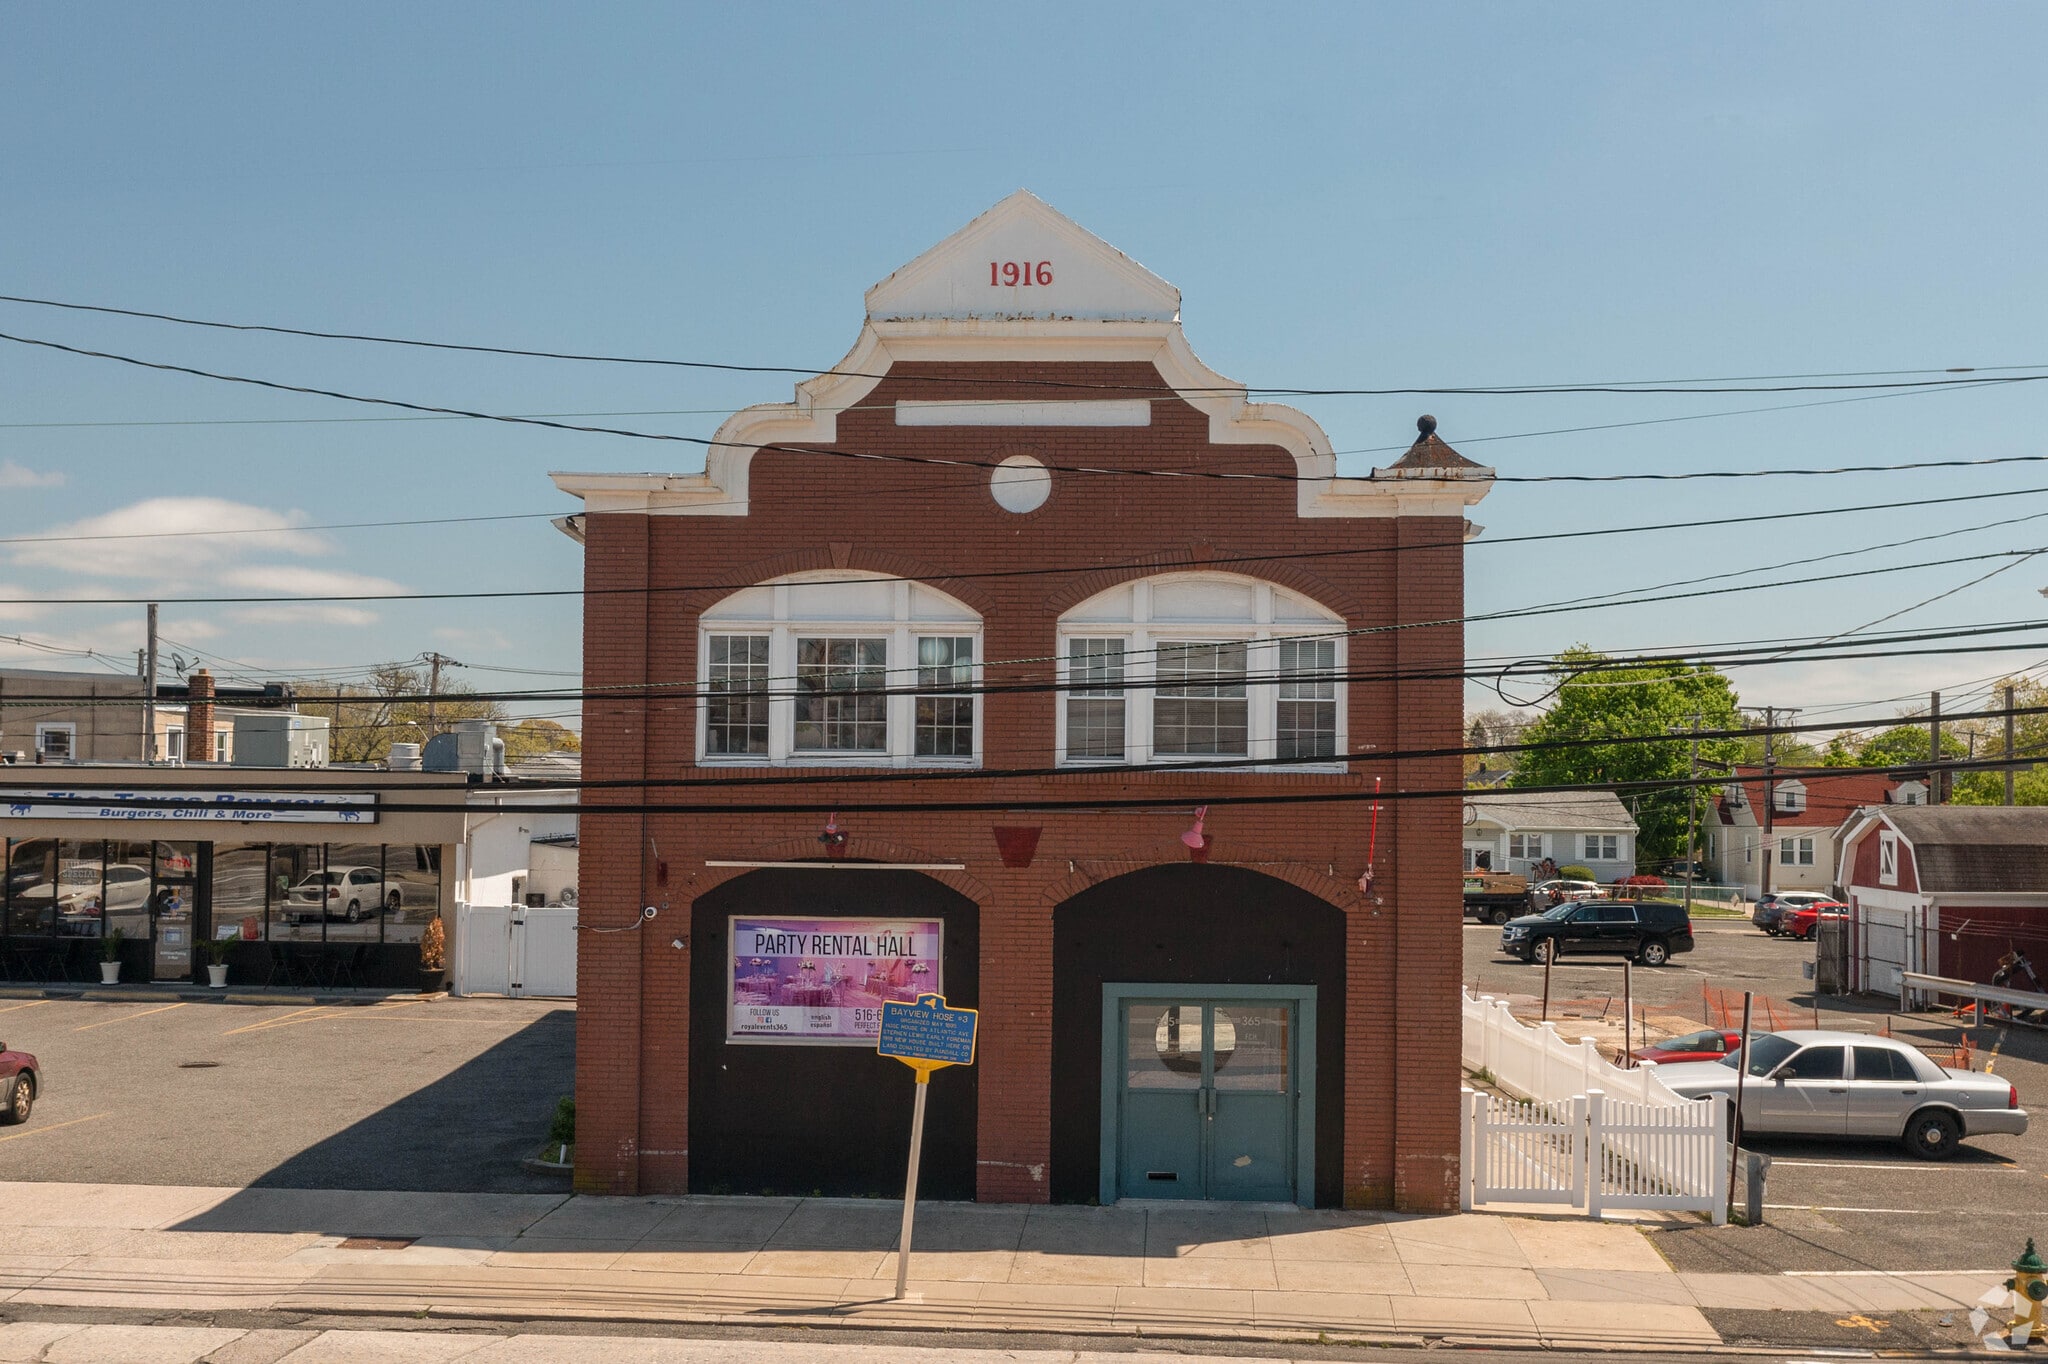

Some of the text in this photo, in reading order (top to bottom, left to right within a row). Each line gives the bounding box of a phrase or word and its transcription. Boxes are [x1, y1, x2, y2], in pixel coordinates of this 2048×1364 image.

[990, 261, 1053, 286] 1916
[99, 808, 272, 820] Burgers, Chili & More
[755, 933, 917, 957] PARTY RENTAL HALL
[749, 1008, 780, 1016] FOLLOW US
[891, 1007, 930, 1019] BAYVIEW
[933, 1012, 955, 1022] HOSE
[810, 1014, 831, 1022] english
[1242, 1016, 1261, 1026] 365
[740, 1023, 788, 1031] royalevents365
[854, 1021, 876, 1030] PERFECT
[930, 1027, 956, 1036] ATLANTIC
[926, 1033, 945, 1041] EARLY
[898, 1044, 923, 1052] DONATED
